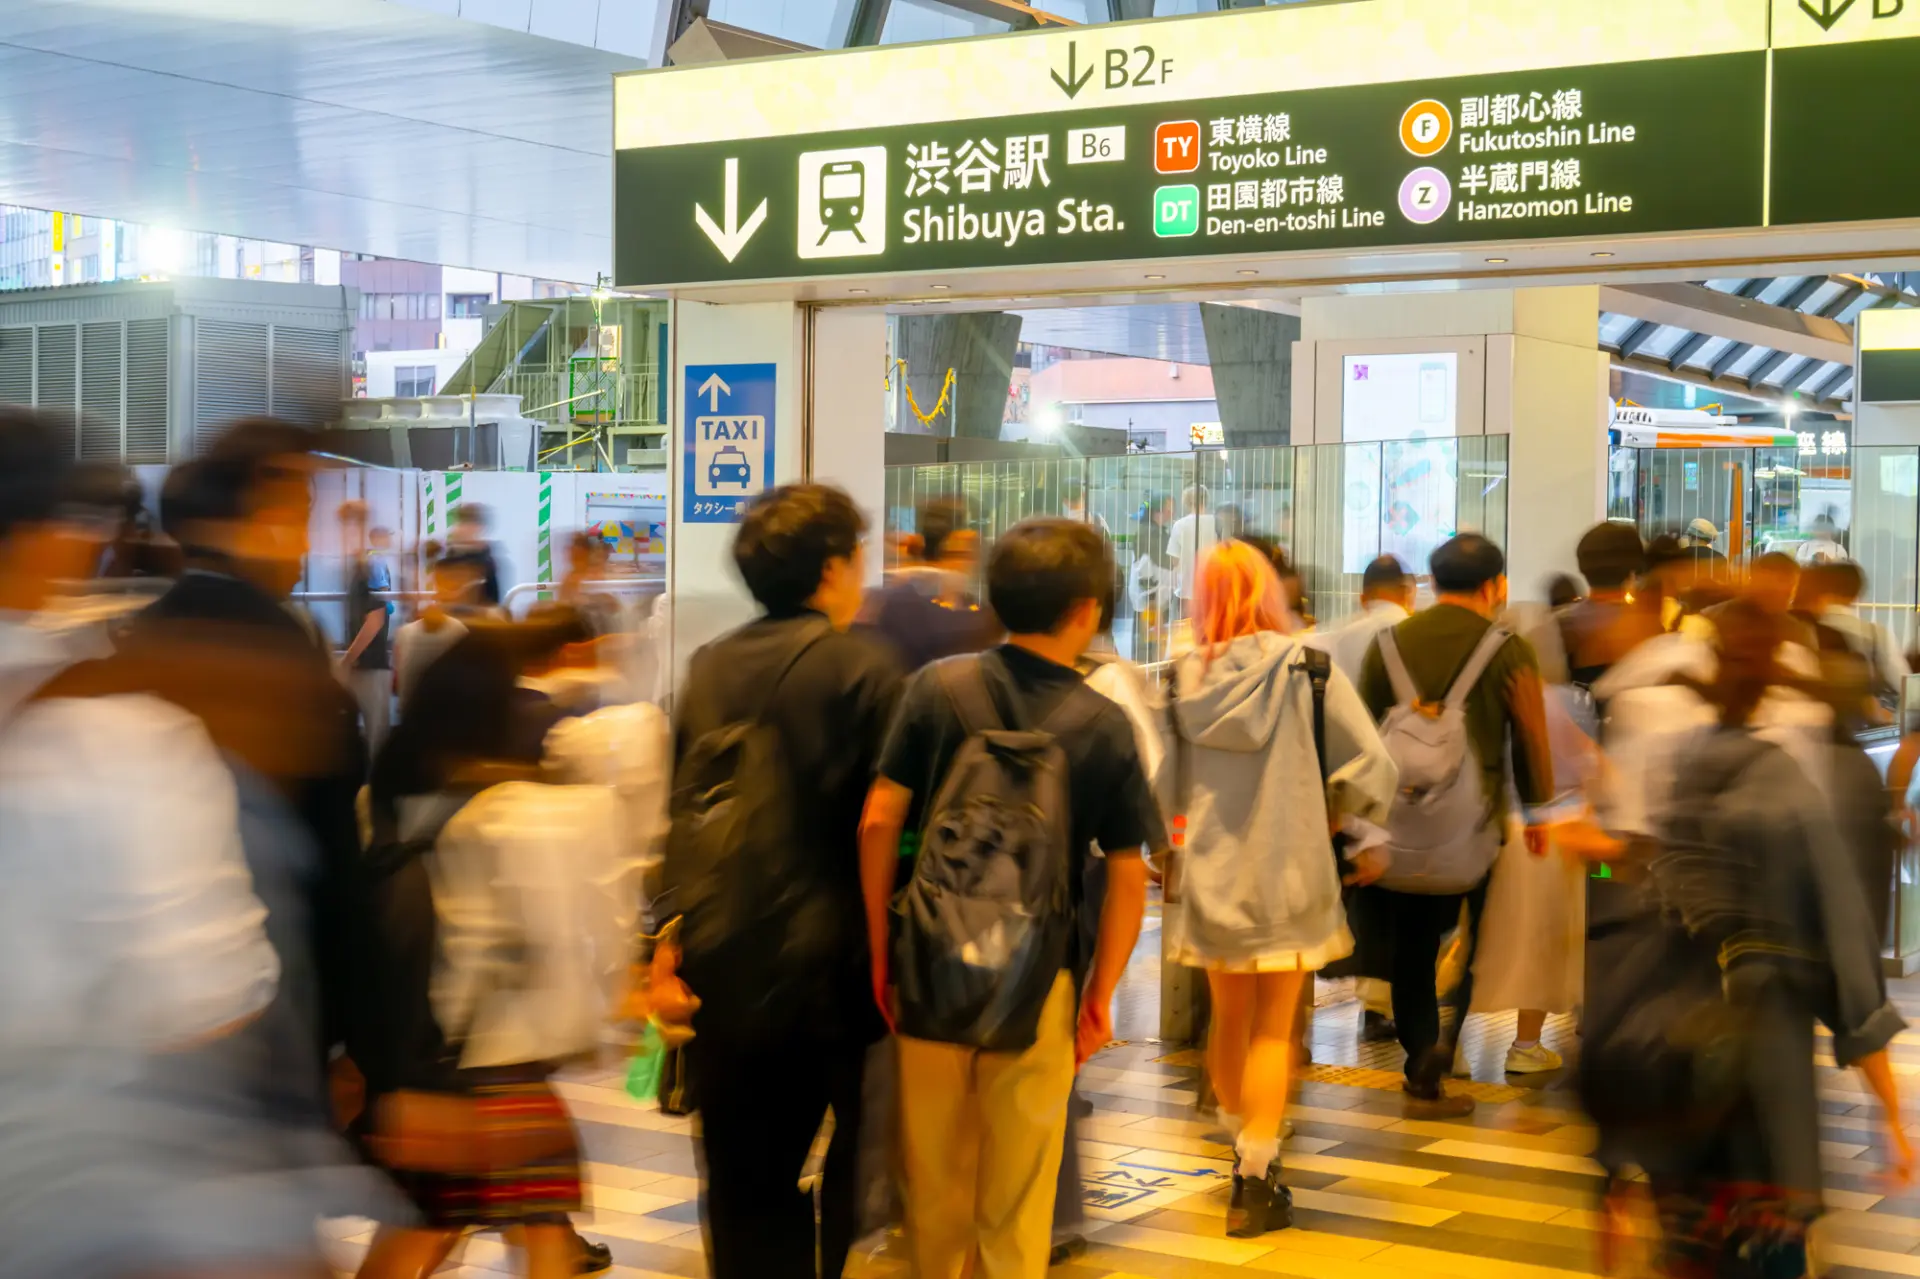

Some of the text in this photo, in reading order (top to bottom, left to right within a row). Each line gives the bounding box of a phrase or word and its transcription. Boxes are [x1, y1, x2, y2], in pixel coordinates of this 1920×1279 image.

[1104, 45, 1174, 89] B2F
[1459, 88, 1583, 129] 副都心線
[1207, 112, 1292, 148] 東横線
[1421, 119, 1432, 138] F
[1459, 122, 1636, 154] Fukutoshin Line
[1081, 132, 1111, 159] B6
[1163, 136, 1194, 158] TY
[1208, 144, 1328, 175] Toyoko Line
[903, 133, 1051, 198] 渋谷駅
[1458, 157, 1582, 197] 半蔵門線
[1206, 173, 1345, 212] 田園都市線
[1417, 186, 1432, 204] Z
[1457, 191, 1633, 221] Hanzomon Line
[902, 197, 1125, 248] Shibuya Sta.
[1161, 199, 1193, 223] DT
[1206, 206, 1385, 236] Den-en-toshi Line
[701, 420, 758, 440] TAXI
